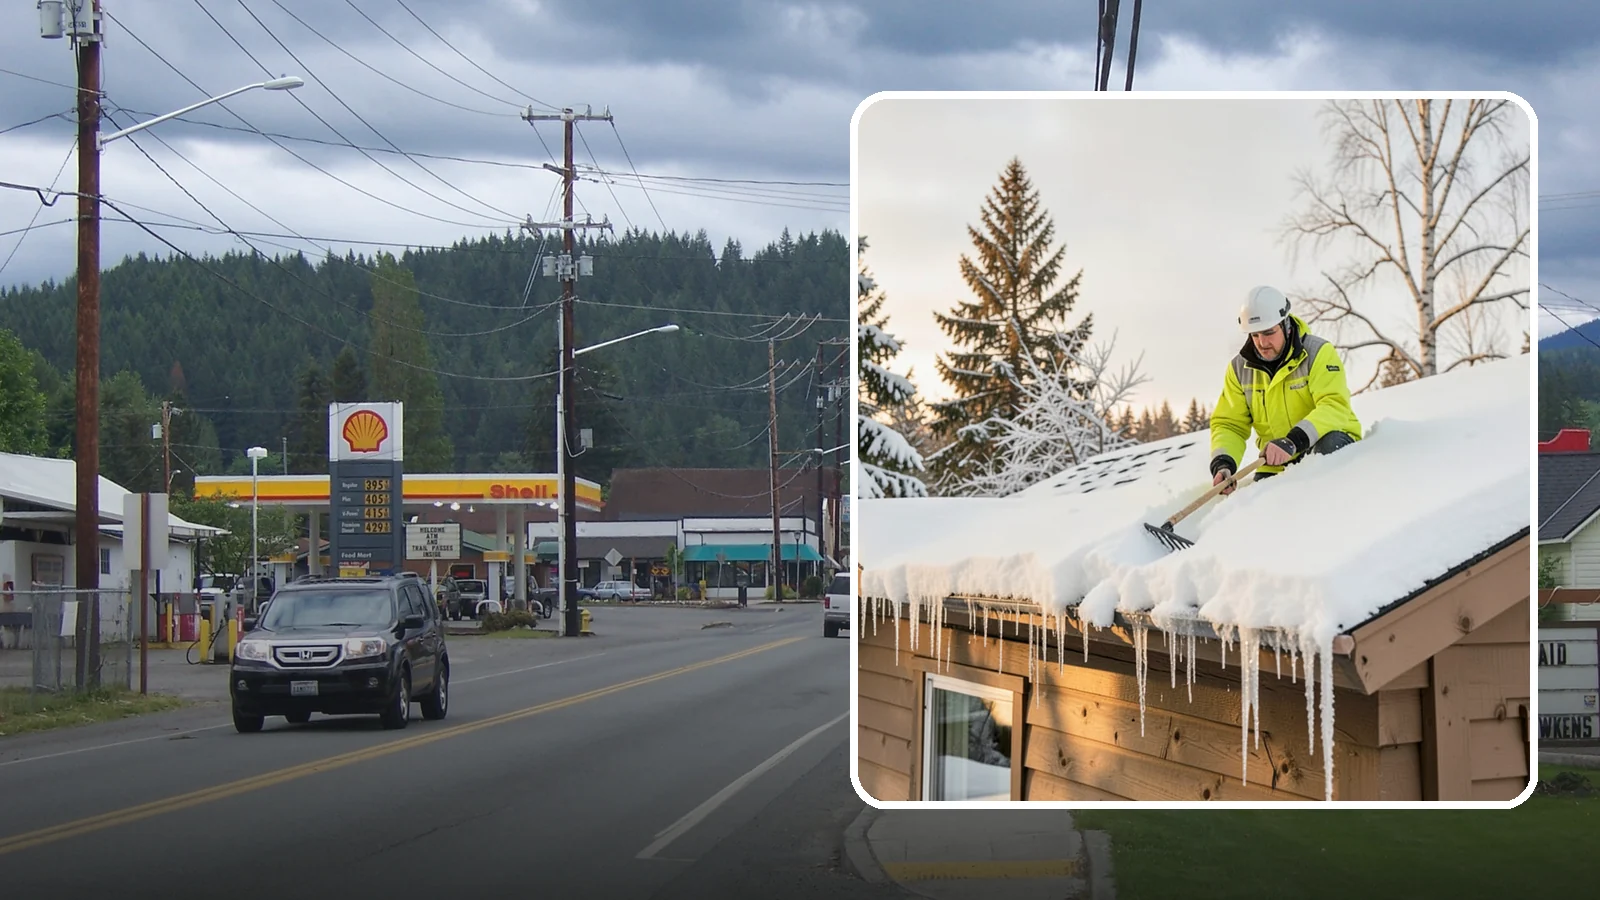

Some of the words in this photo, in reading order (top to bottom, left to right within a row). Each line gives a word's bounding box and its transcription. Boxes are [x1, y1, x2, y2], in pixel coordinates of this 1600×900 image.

[366, 480, 383, 490] 395
[490, 484, 547, 499] Shell
[366, 494, 383, 504] 405
[366, 508, 383, 518] 415
[366, 522, 383, 532] 429
[1539, 643, 1566, 665] AID
